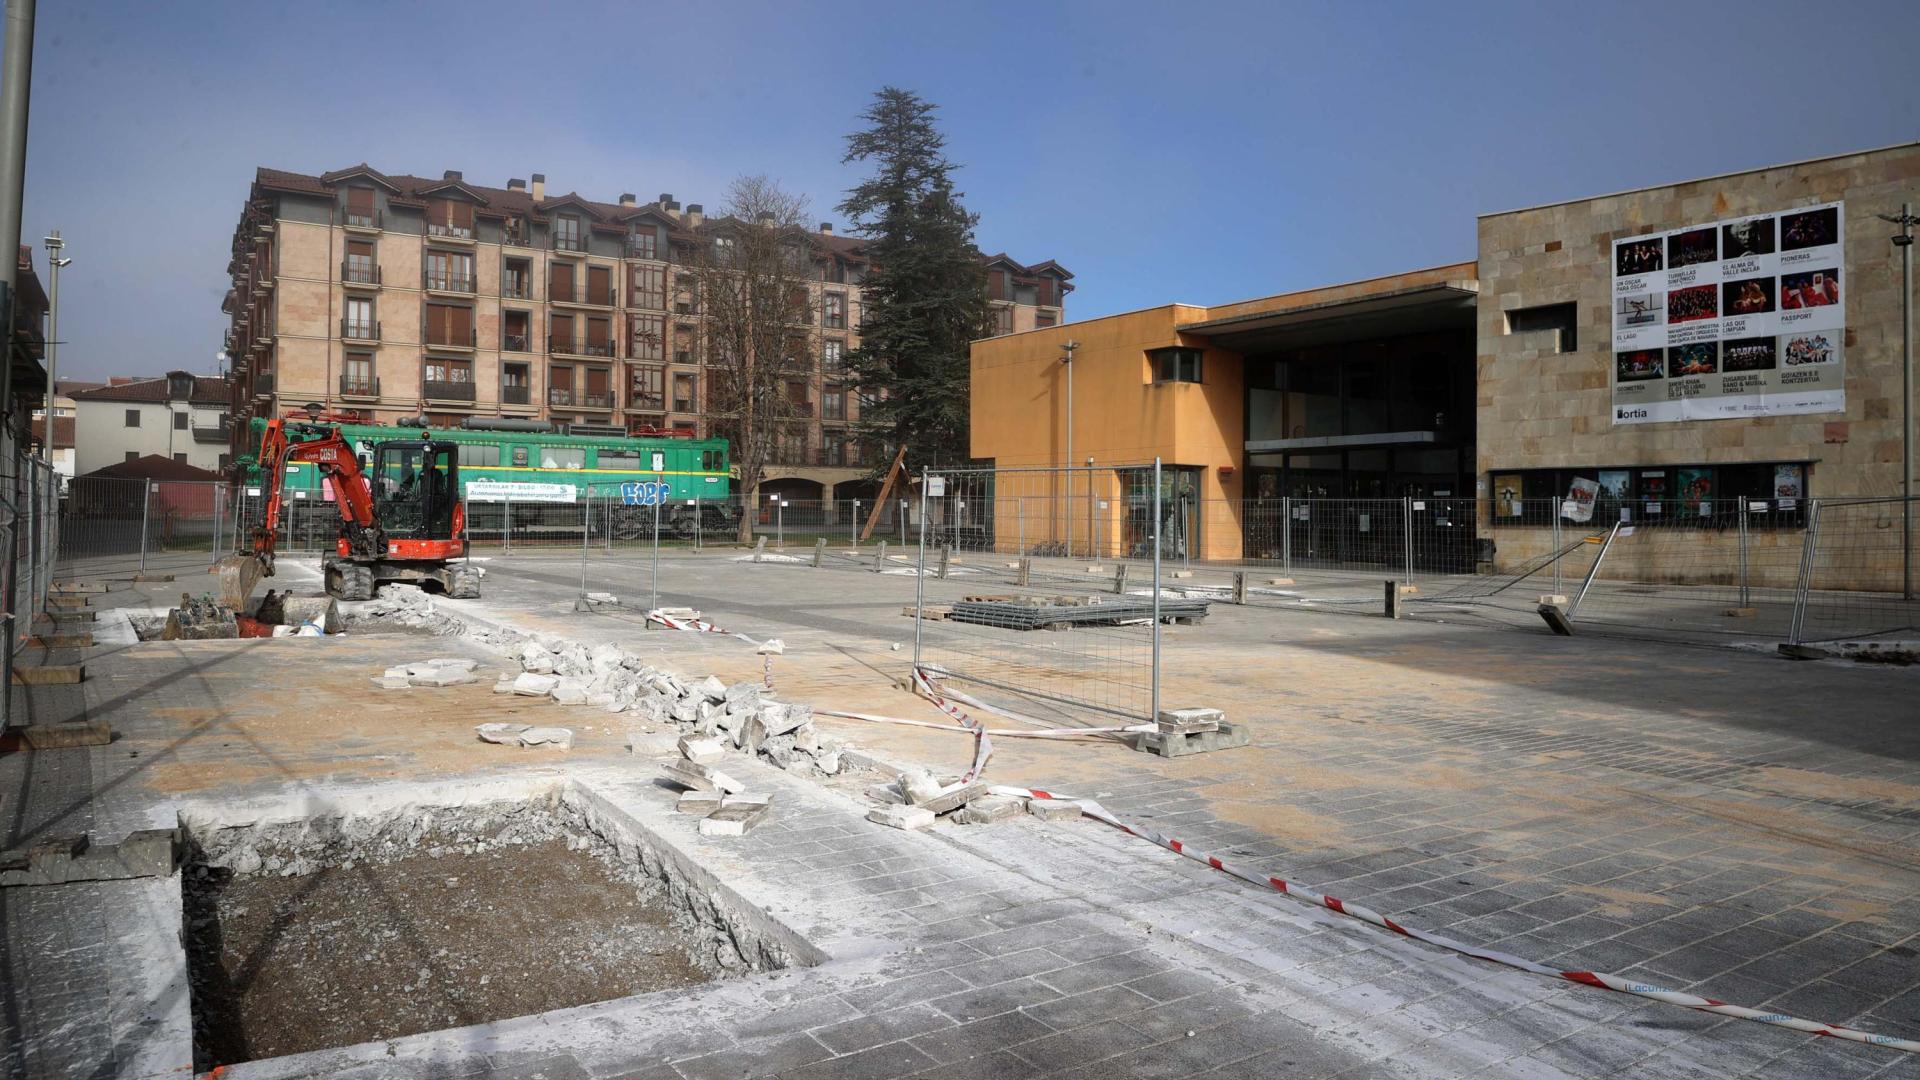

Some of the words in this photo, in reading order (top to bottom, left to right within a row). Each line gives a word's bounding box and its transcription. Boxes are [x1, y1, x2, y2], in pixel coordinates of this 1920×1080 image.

[1781, 253, 1811, 262] PIONERAS
[1722, 268, 1739, 276] VALLE
[1781, 313, 1812, 321] PASSPORT
[1722, 326, 1746, 334] LIMPIAN
[1781, 376, 1820, 384] KONTZERTUA
[1628, 983, 1674, 993] Lacunz
